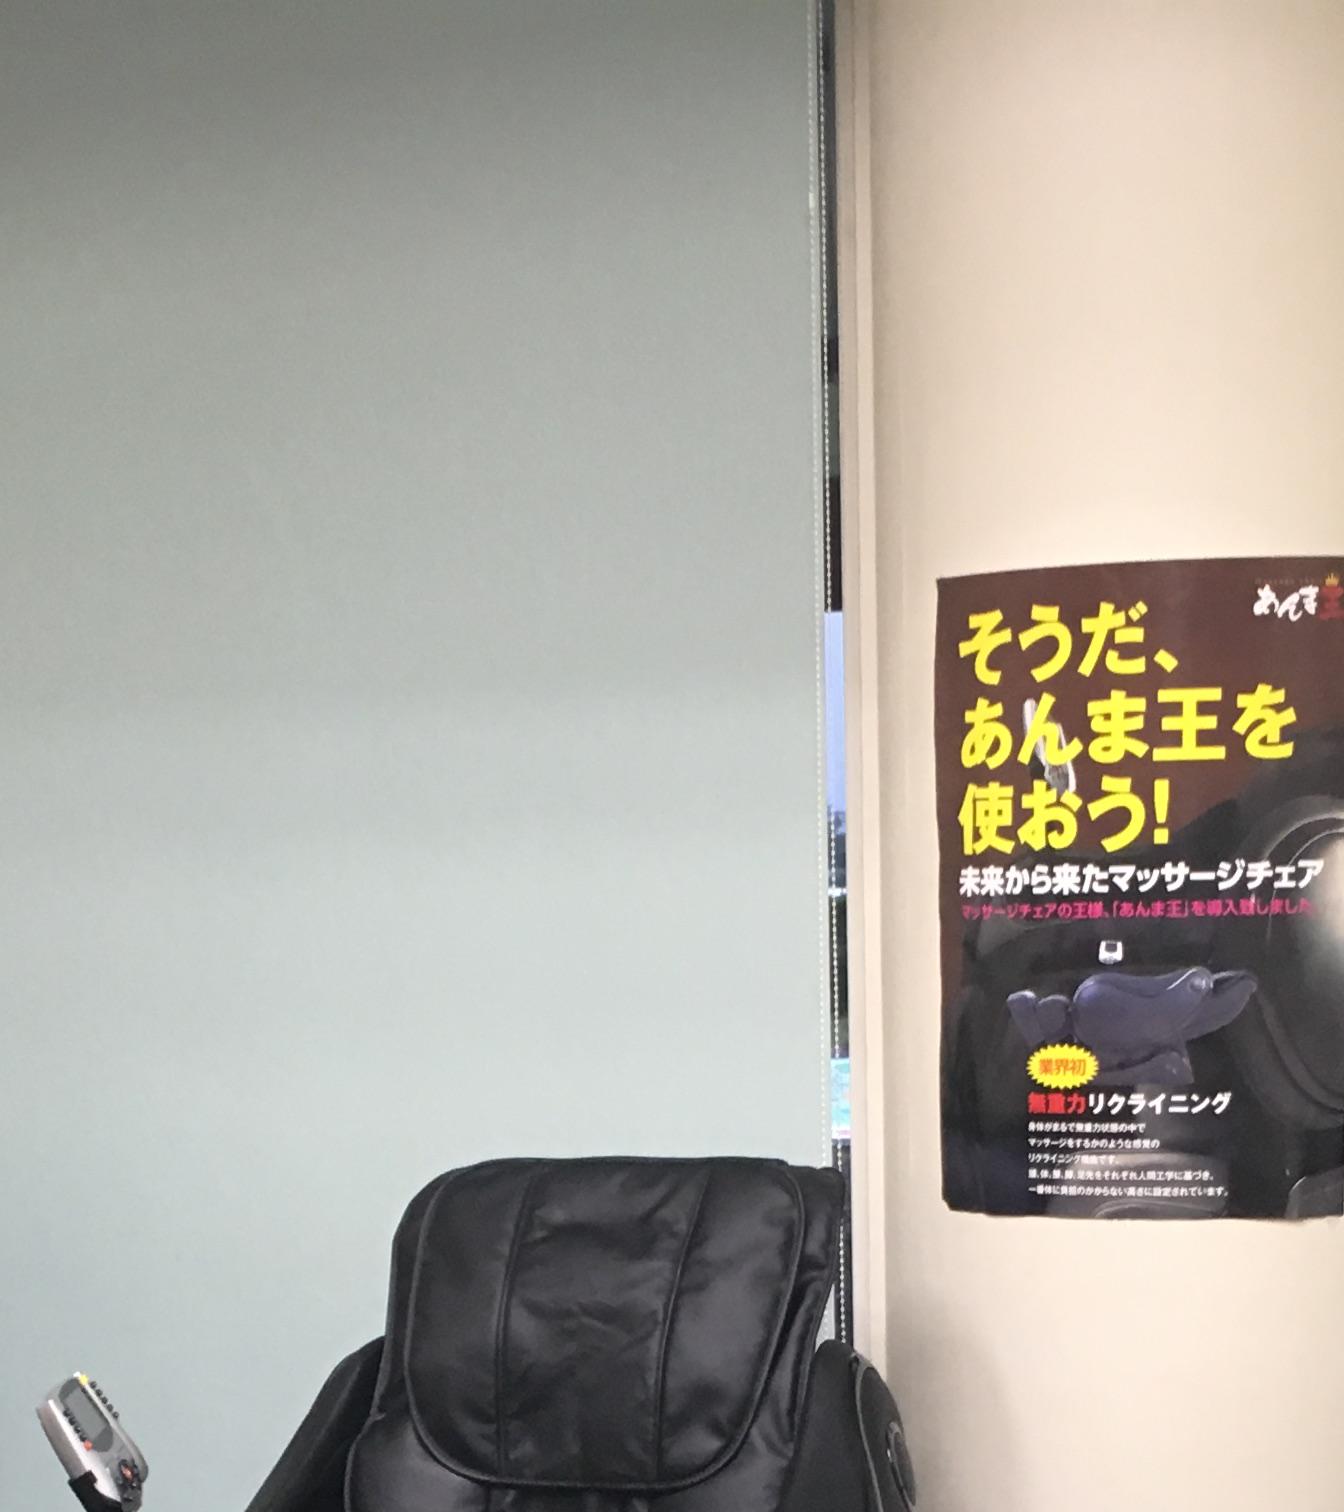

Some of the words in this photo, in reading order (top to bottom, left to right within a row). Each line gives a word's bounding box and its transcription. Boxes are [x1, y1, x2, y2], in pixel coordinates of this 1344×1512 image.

[958, 601, 1178, 685] そうだ、
[960, 683, 1297, 770] あんま王を
[958, 775, 1170, 855] 使おう!
[959, 858, 1325, 897] 未来から来たマッサージチェア
[1038, 1058, 1087, 1077] 業界初
[1027, 1091, 1233, 1115] 無重力リクライニング
